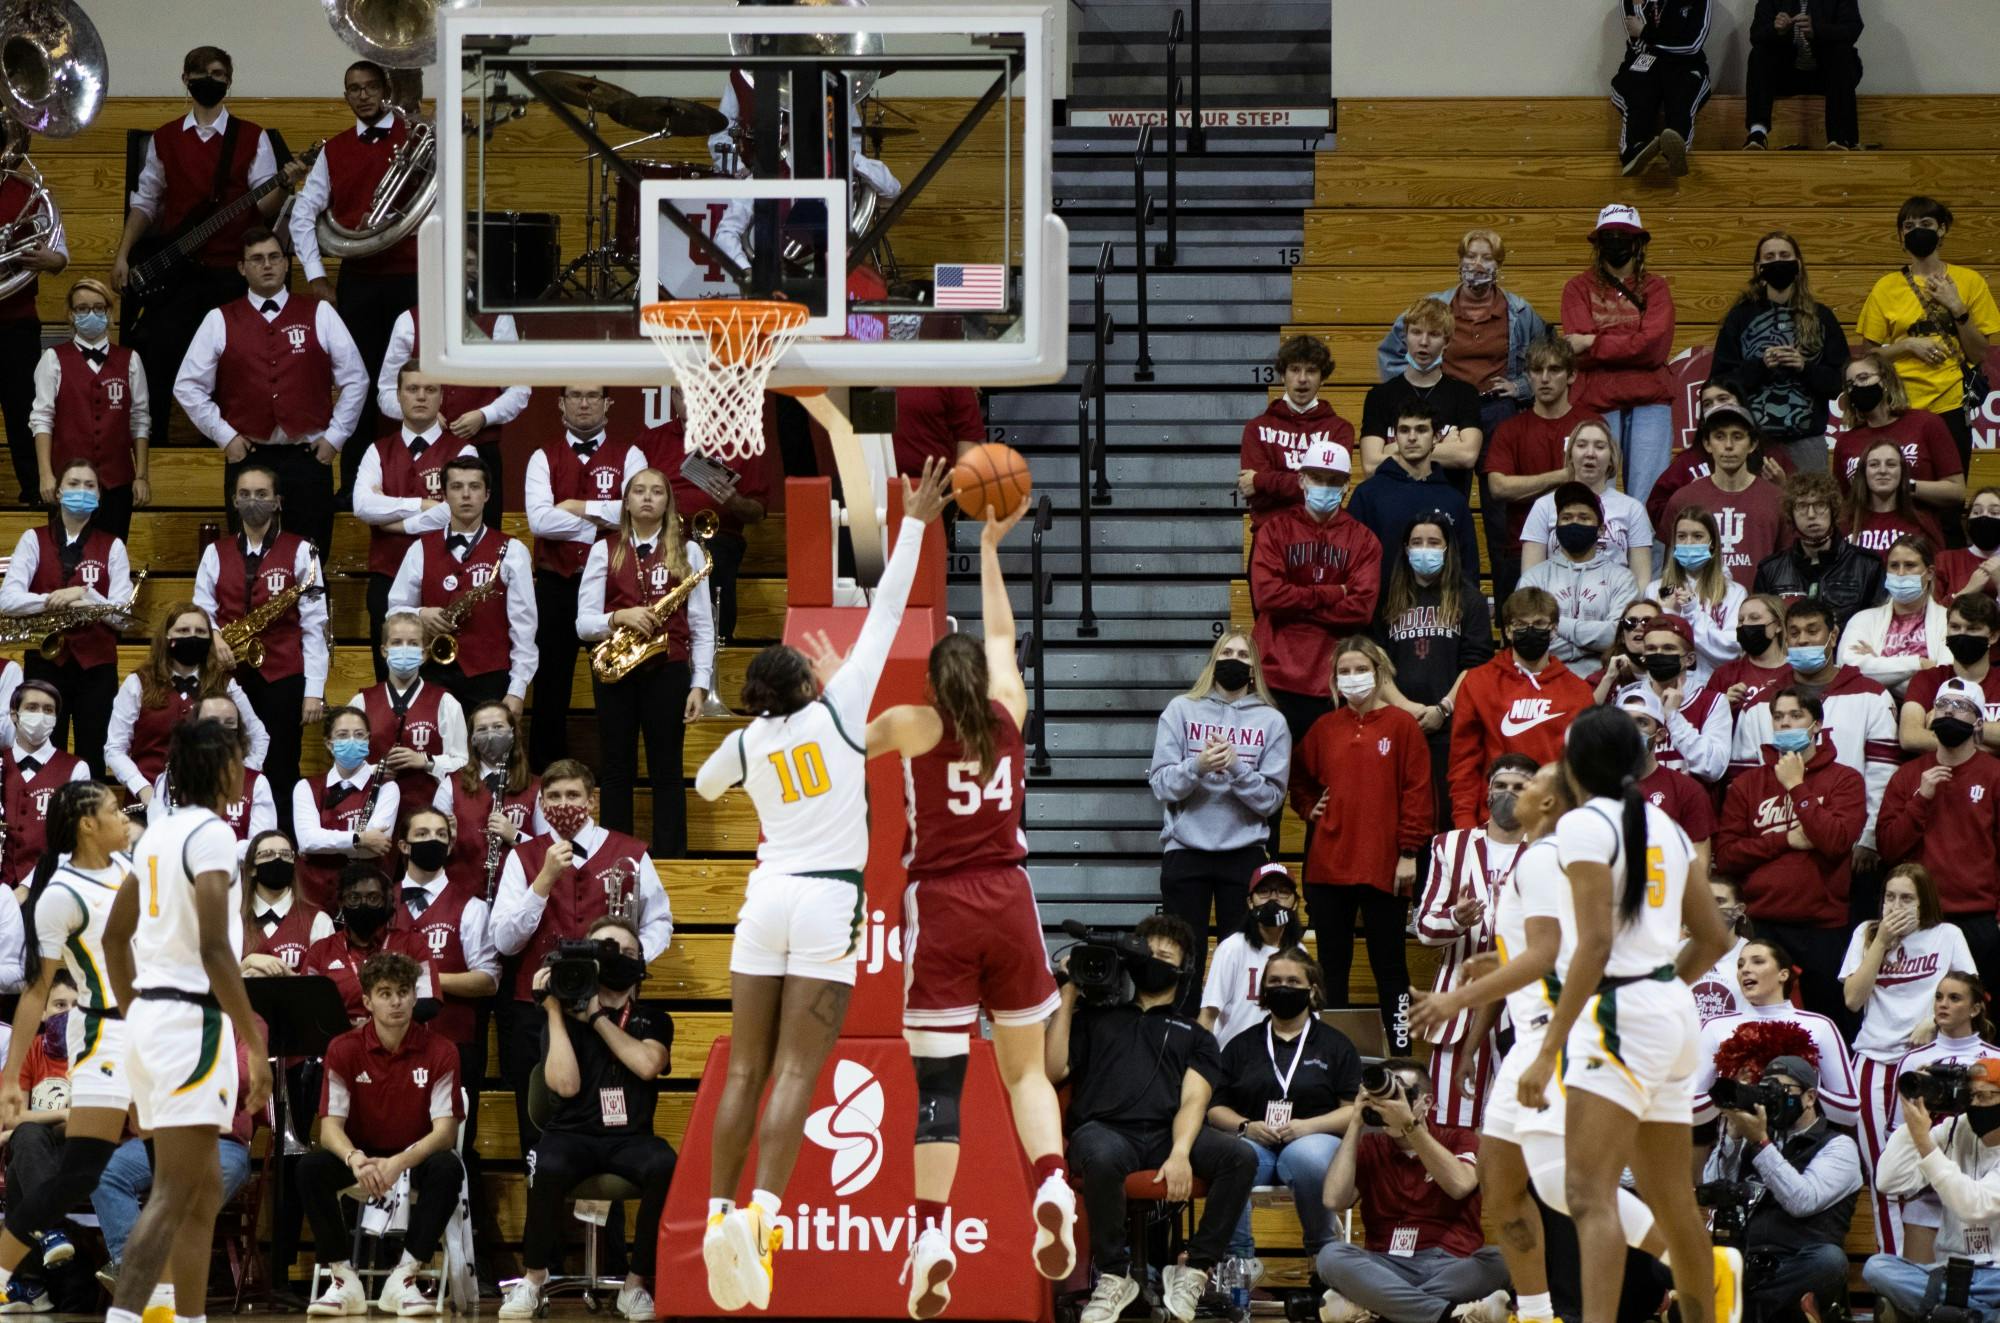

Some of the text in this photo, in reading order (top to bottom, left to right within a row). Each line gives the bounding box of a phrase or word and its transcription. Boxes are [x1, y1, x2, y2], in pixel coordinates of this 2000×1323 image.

[1108, 112, 1168, 127] WATCH
[1236, 111, 1289, 126] STEP!
[1278, 248, 1300, 265] 15
[1251, 366, 1275, 383] 13
[985, 427, 1006, 443] 12
[948, 555, 970, 572] 10
[1555, 586, 1598, 603] INNA
[1212, 621, 1224, 639] 9
[1510, 698, 1553, 720] NIKE
[768, 742, 833, 804] 10
[947, 756, 1013, 816] 54
[148, 855, 159, 917] 1
[1393, 993, 1410, 1048] adidas
